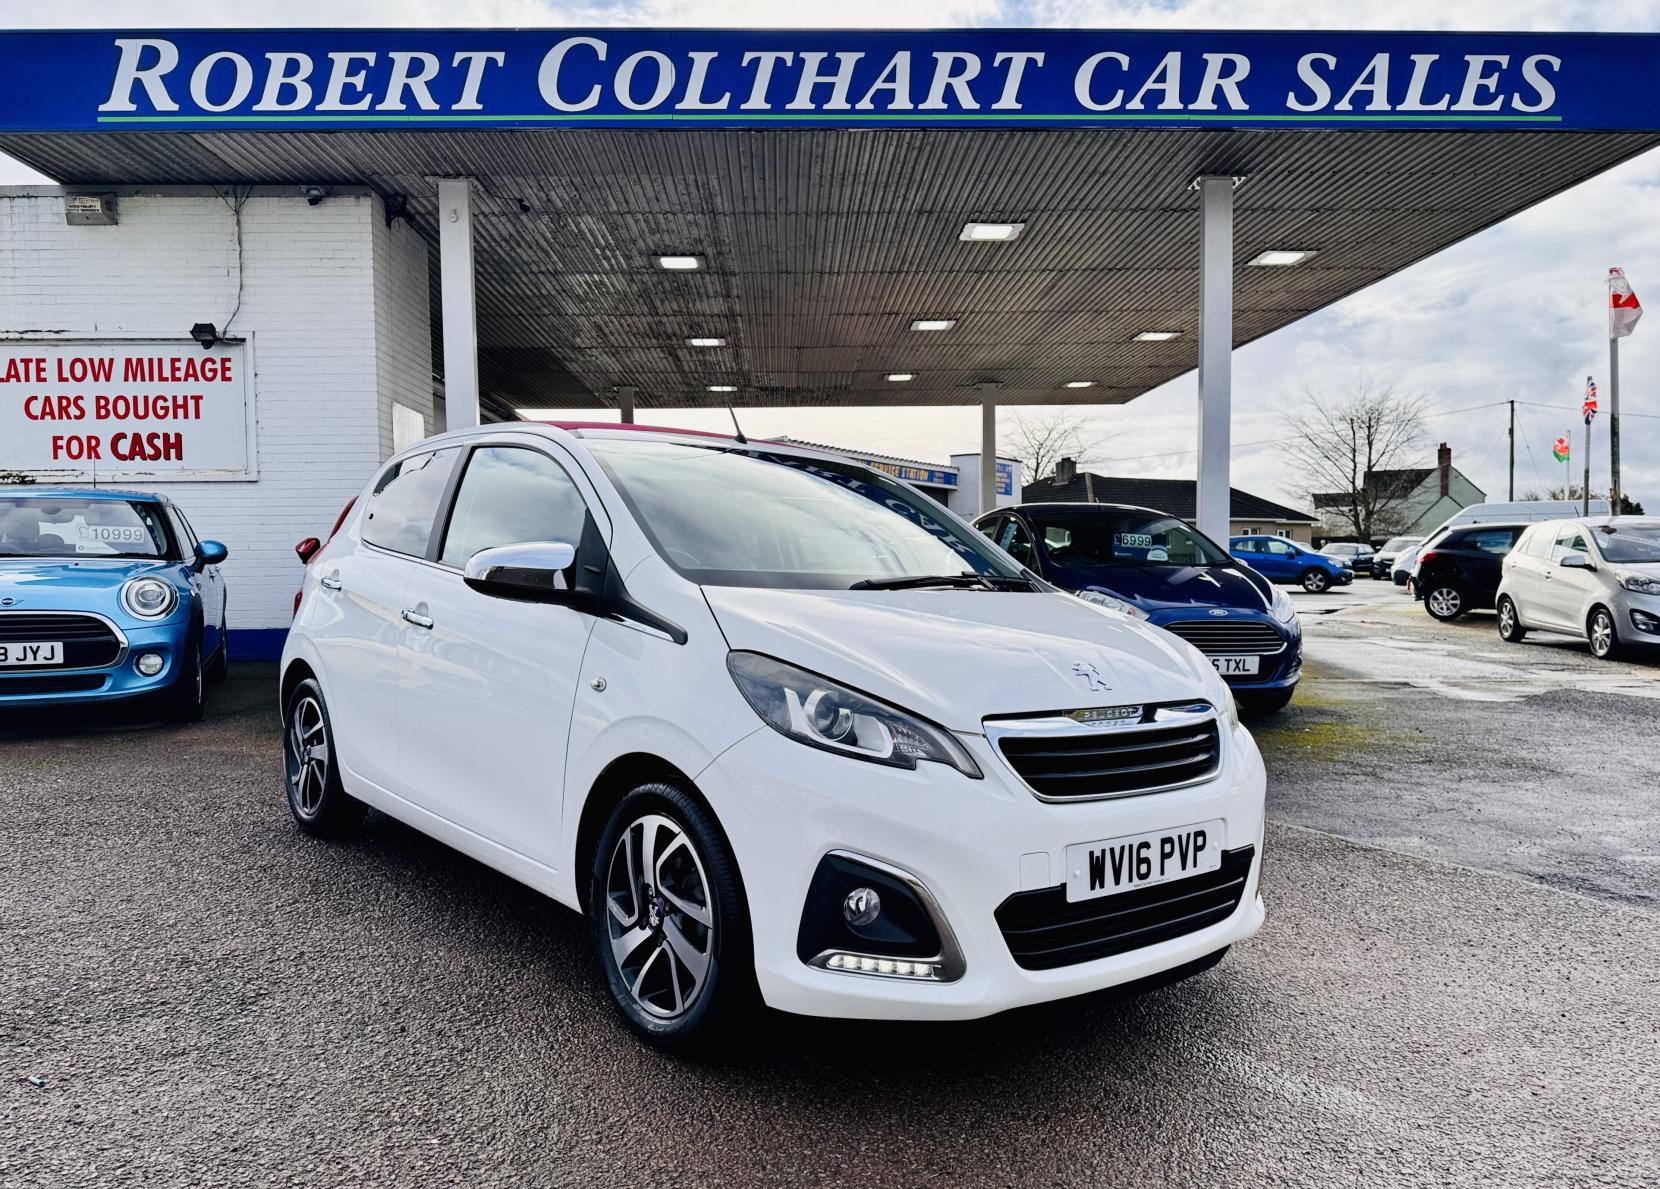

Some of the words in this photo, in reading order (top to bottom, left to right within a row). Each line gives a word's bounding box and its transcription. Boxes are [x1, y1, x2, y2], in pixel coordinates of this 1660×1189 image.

[98, 38, 506, 112] ROBERT
[538, 37, 1045, 111] COLTHART
[1073, 51, 1251, 112] CAR
[1286, 53, 1562, 113] SALES
[57, 358, 115, 383] LOW
[123, 357, 232, 382] MILEAGE
[24, 395, 86, 420] CARS
[95, 395, 203, 420] BOUGHT
[52, 436, 102, 460] FOR
[110, 432, 183, 461] CASH
[901, 466, 928, 481] STATION
[15, 645, 55, 661] JYJ
[1224, 658, 1251, 672] TXL
[1088, 840, 1152, 892] WV16
[1160, 829, 1207, 877] PVP
